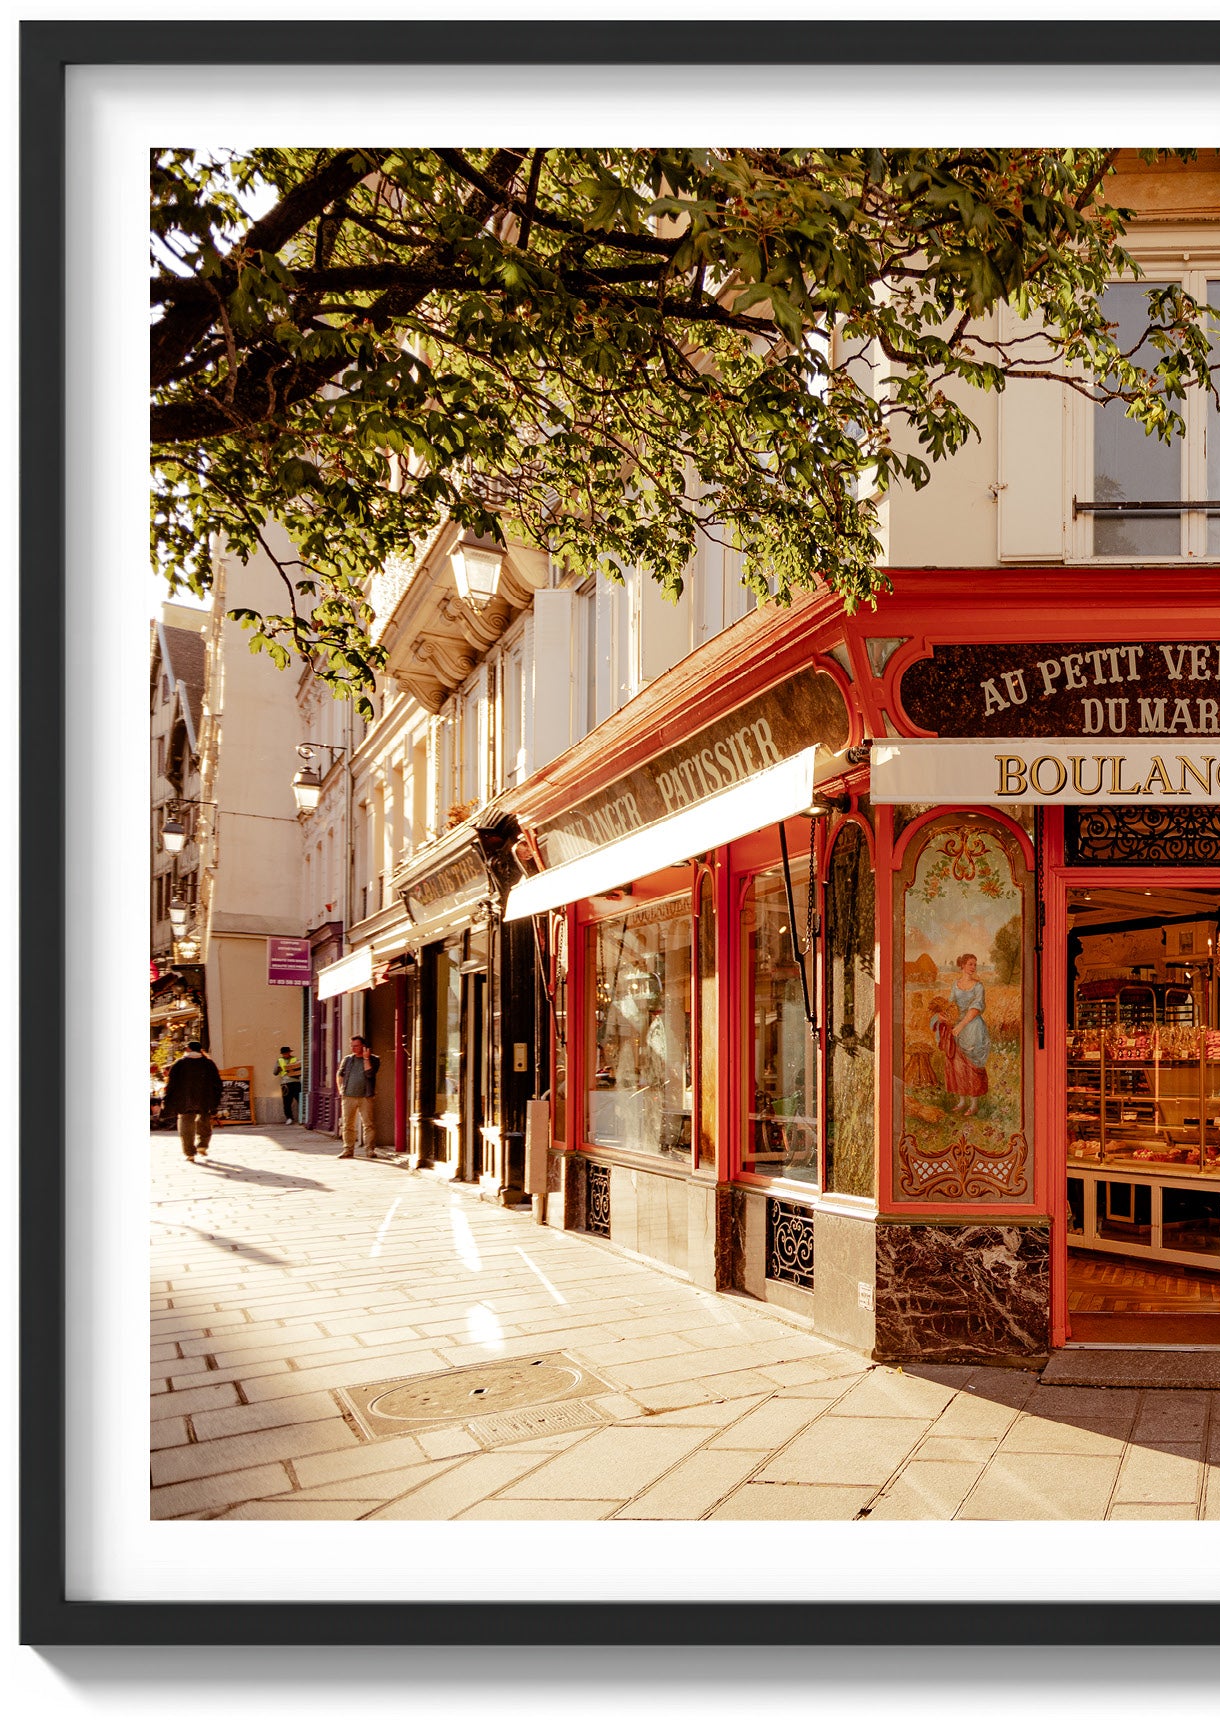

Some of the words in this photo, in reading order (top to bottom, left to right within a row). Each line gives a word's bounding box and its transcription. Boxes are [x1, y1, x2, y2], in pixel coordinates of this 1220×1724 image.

[980, 670, 1030, 717] AU
[1036, 645, 1145, 697] PETIT
[1081, 698, 1131, 734] DU
